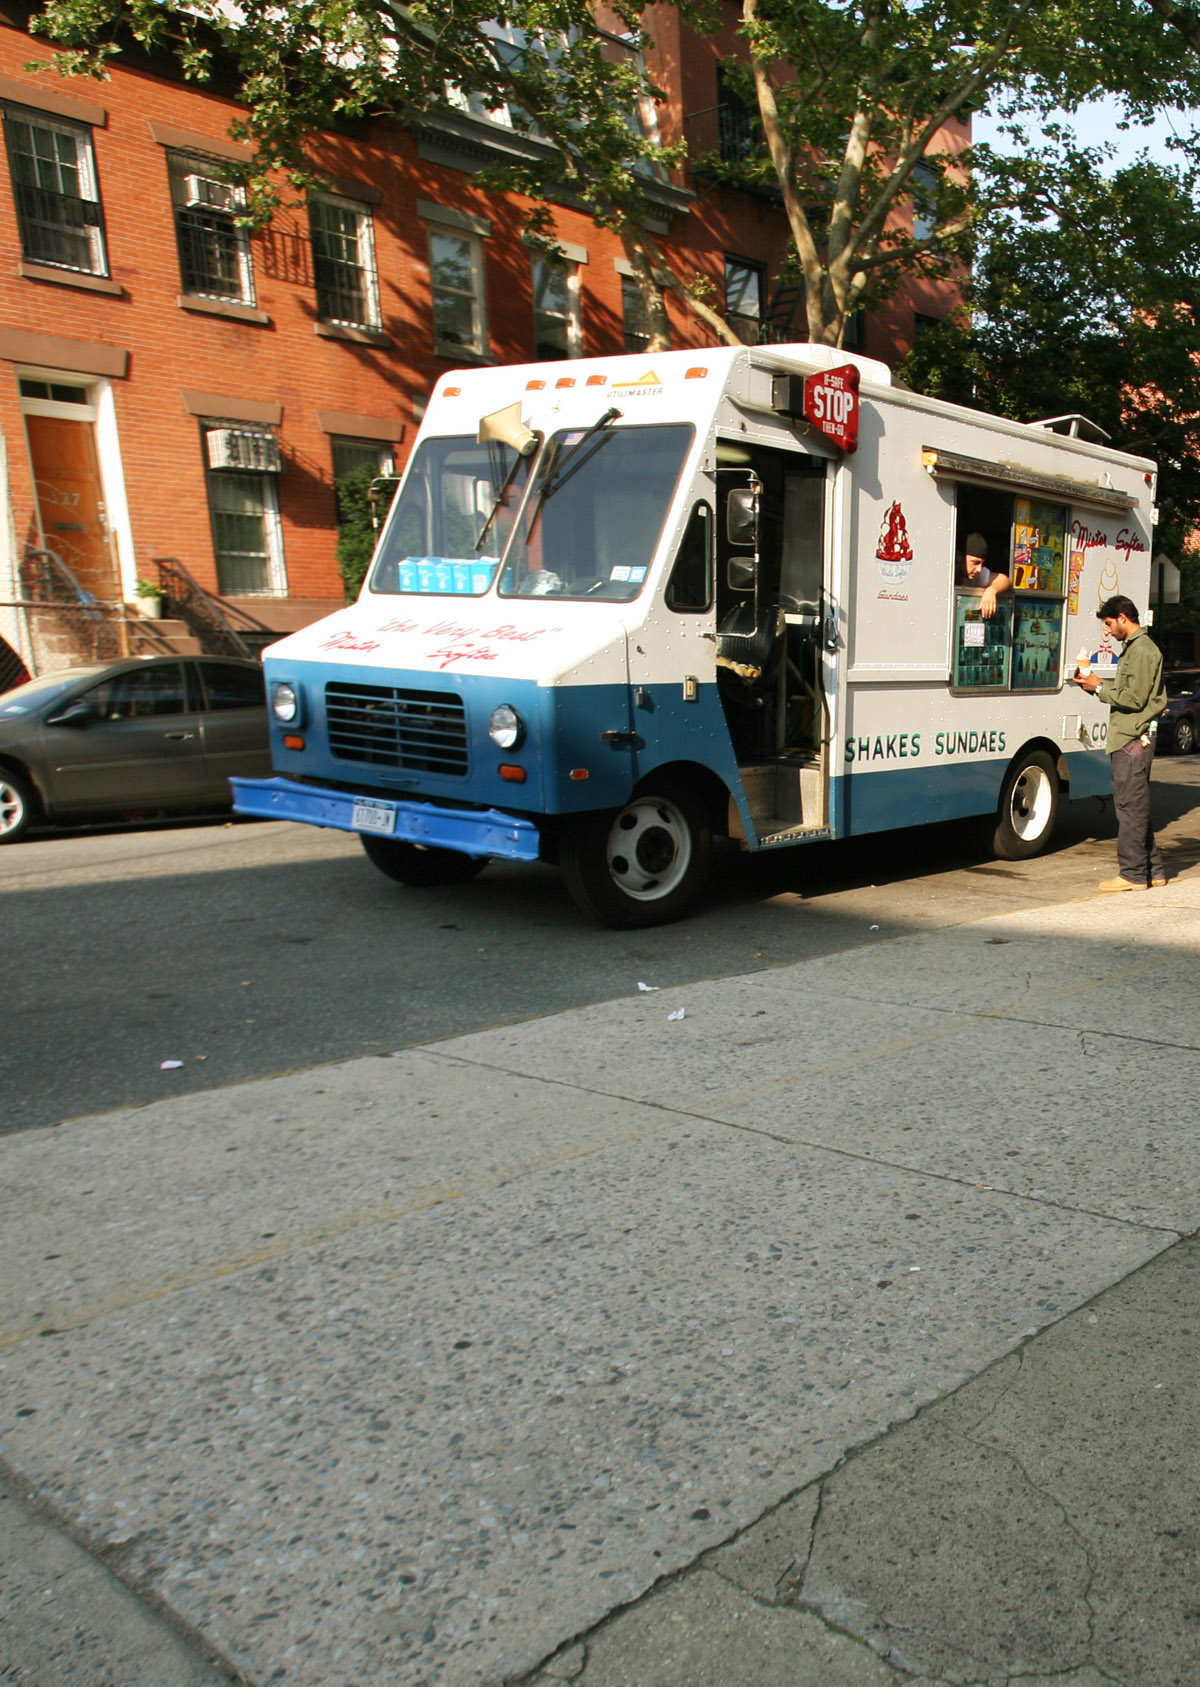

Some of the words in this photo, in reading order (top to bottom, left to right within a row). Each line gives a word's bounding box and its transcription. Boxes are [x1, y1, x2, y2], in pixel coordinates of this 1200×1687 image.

[607, 388, 663, 398] UTILIMASTER
[824, 374, 844, 389] IF-SAFE
[813, 385, 854, 424] STOP
[844, 733, 921, 762] SHAKES
[935, 730, 1006, 755] SUNDAES
